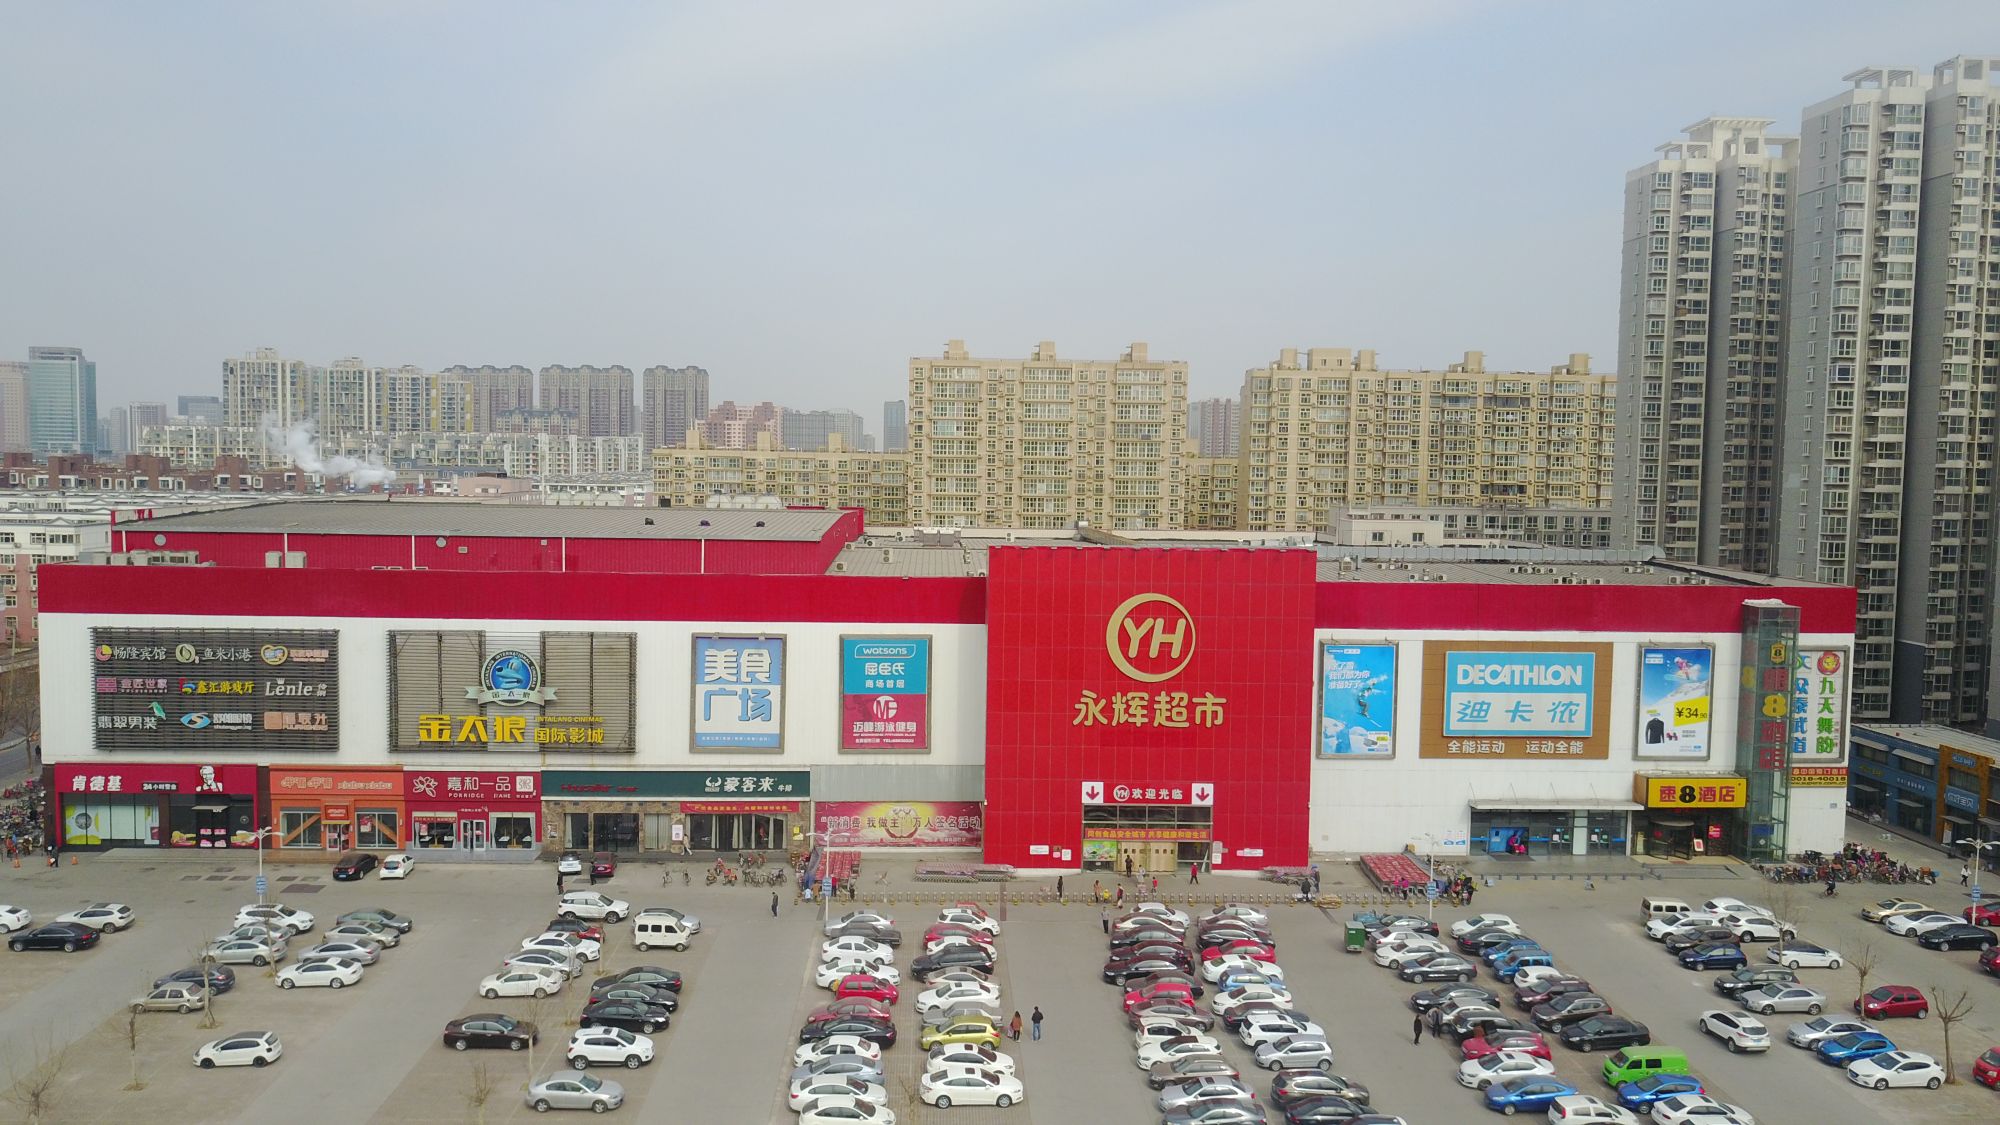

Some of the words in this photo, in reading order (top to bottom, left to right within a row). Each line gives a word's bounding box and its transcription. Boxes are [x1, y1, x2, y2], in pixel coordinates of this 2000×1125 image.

[1123, 617, 1186, 659] YH
[202, 647, 253, 662] 鱼米小港
[704, 648, 772, 683] 美食
[864, 662, 905, 676] 屈臣氏
[1457, 664, 1583, 686] DECATHLON
[197, 680, 255, 695] 鑫汇游戏厅
[265, 681, 313, 696] Lenle
[703, 687, 772, 722] 广场
[1073, 690, 1228, 728] 永辉超市
[1456, 700, 1581, 723] 迪卡侬
[97, 715, 158, 730] 翡翠男装
[418, 713, 527, 743] 金太狼
[534, 728, 605, 744] 国际影城
[1447, 739, 1505, 754] 全能运动
[1526, 740, 1584, 754] 运动全能
[72, 775, 122, 792] 肯德基
[447, 776, 511, 791] 嘉和一品
[724, 776, 775, 792] 豪客来
[1132, 788, 1184, 800] 欢迎光临
[1659, 785, 1736, 804] 速8酒店
[912, 816, 982, 830] 万人签名活动
